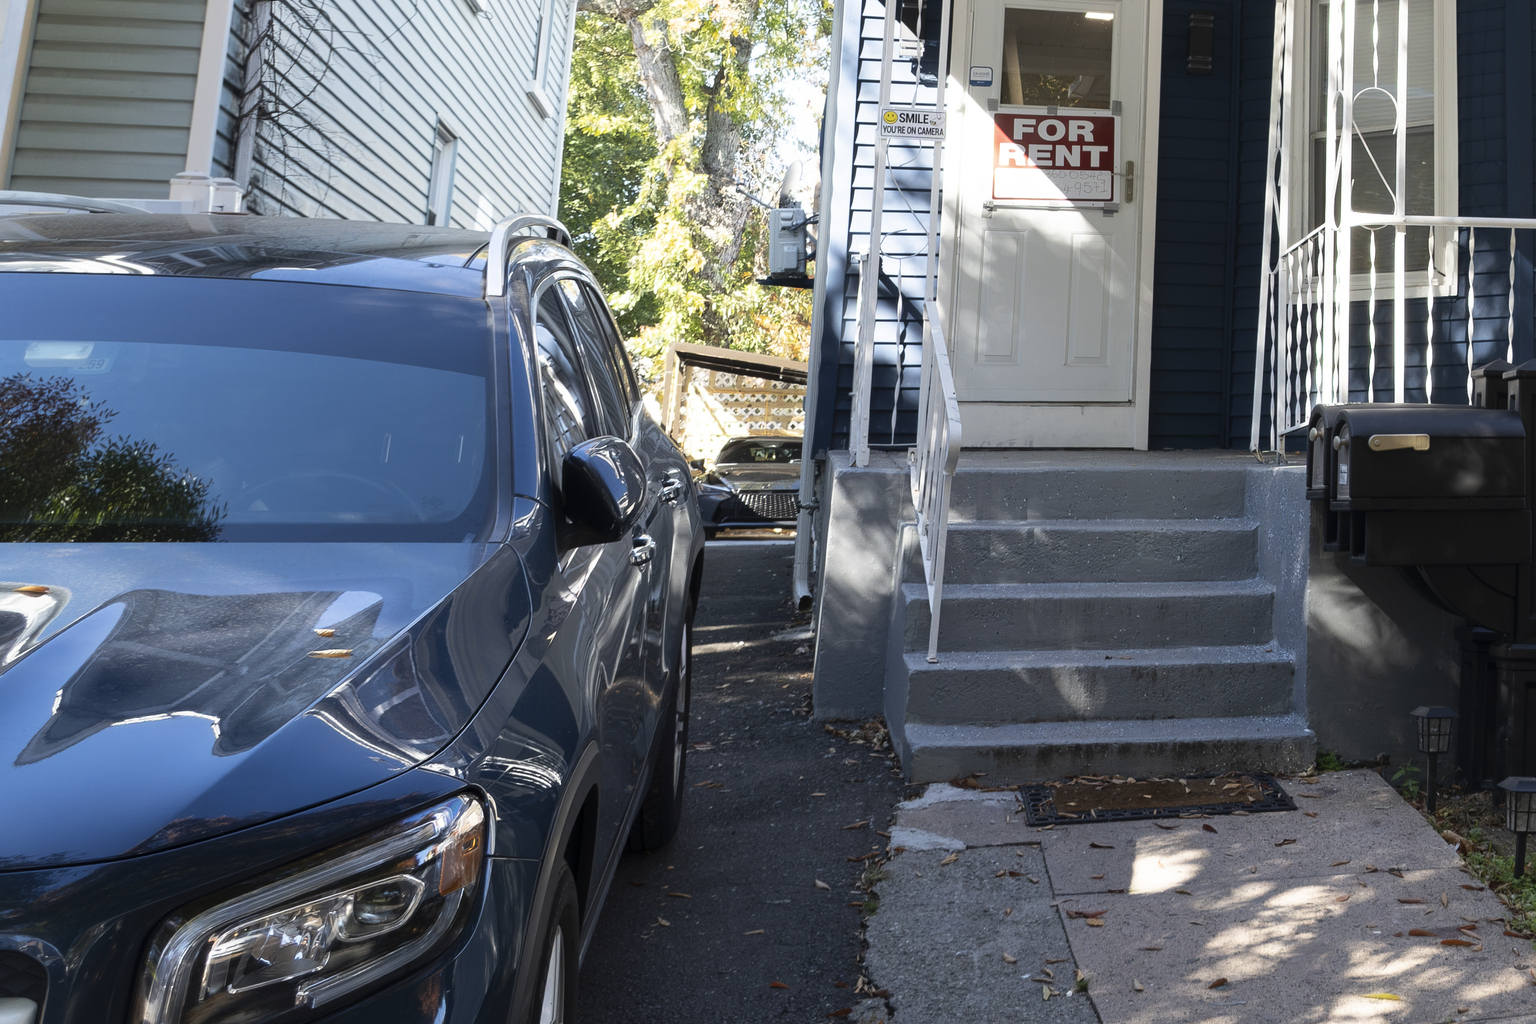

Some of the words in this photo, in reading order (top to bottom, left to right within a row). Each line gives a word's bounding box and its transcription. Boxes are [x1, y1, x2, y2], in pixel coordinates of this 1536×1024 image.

[899, 112, 929, 125] SMILE
[882, 125, 906, 134] YOU'RE
[906, 126, 917, 135] ON
[917, 126, 944, 136] CAMERA
[1013, 118, 1095, 142] FOR
[998, 142, 1109, 168] RENT
